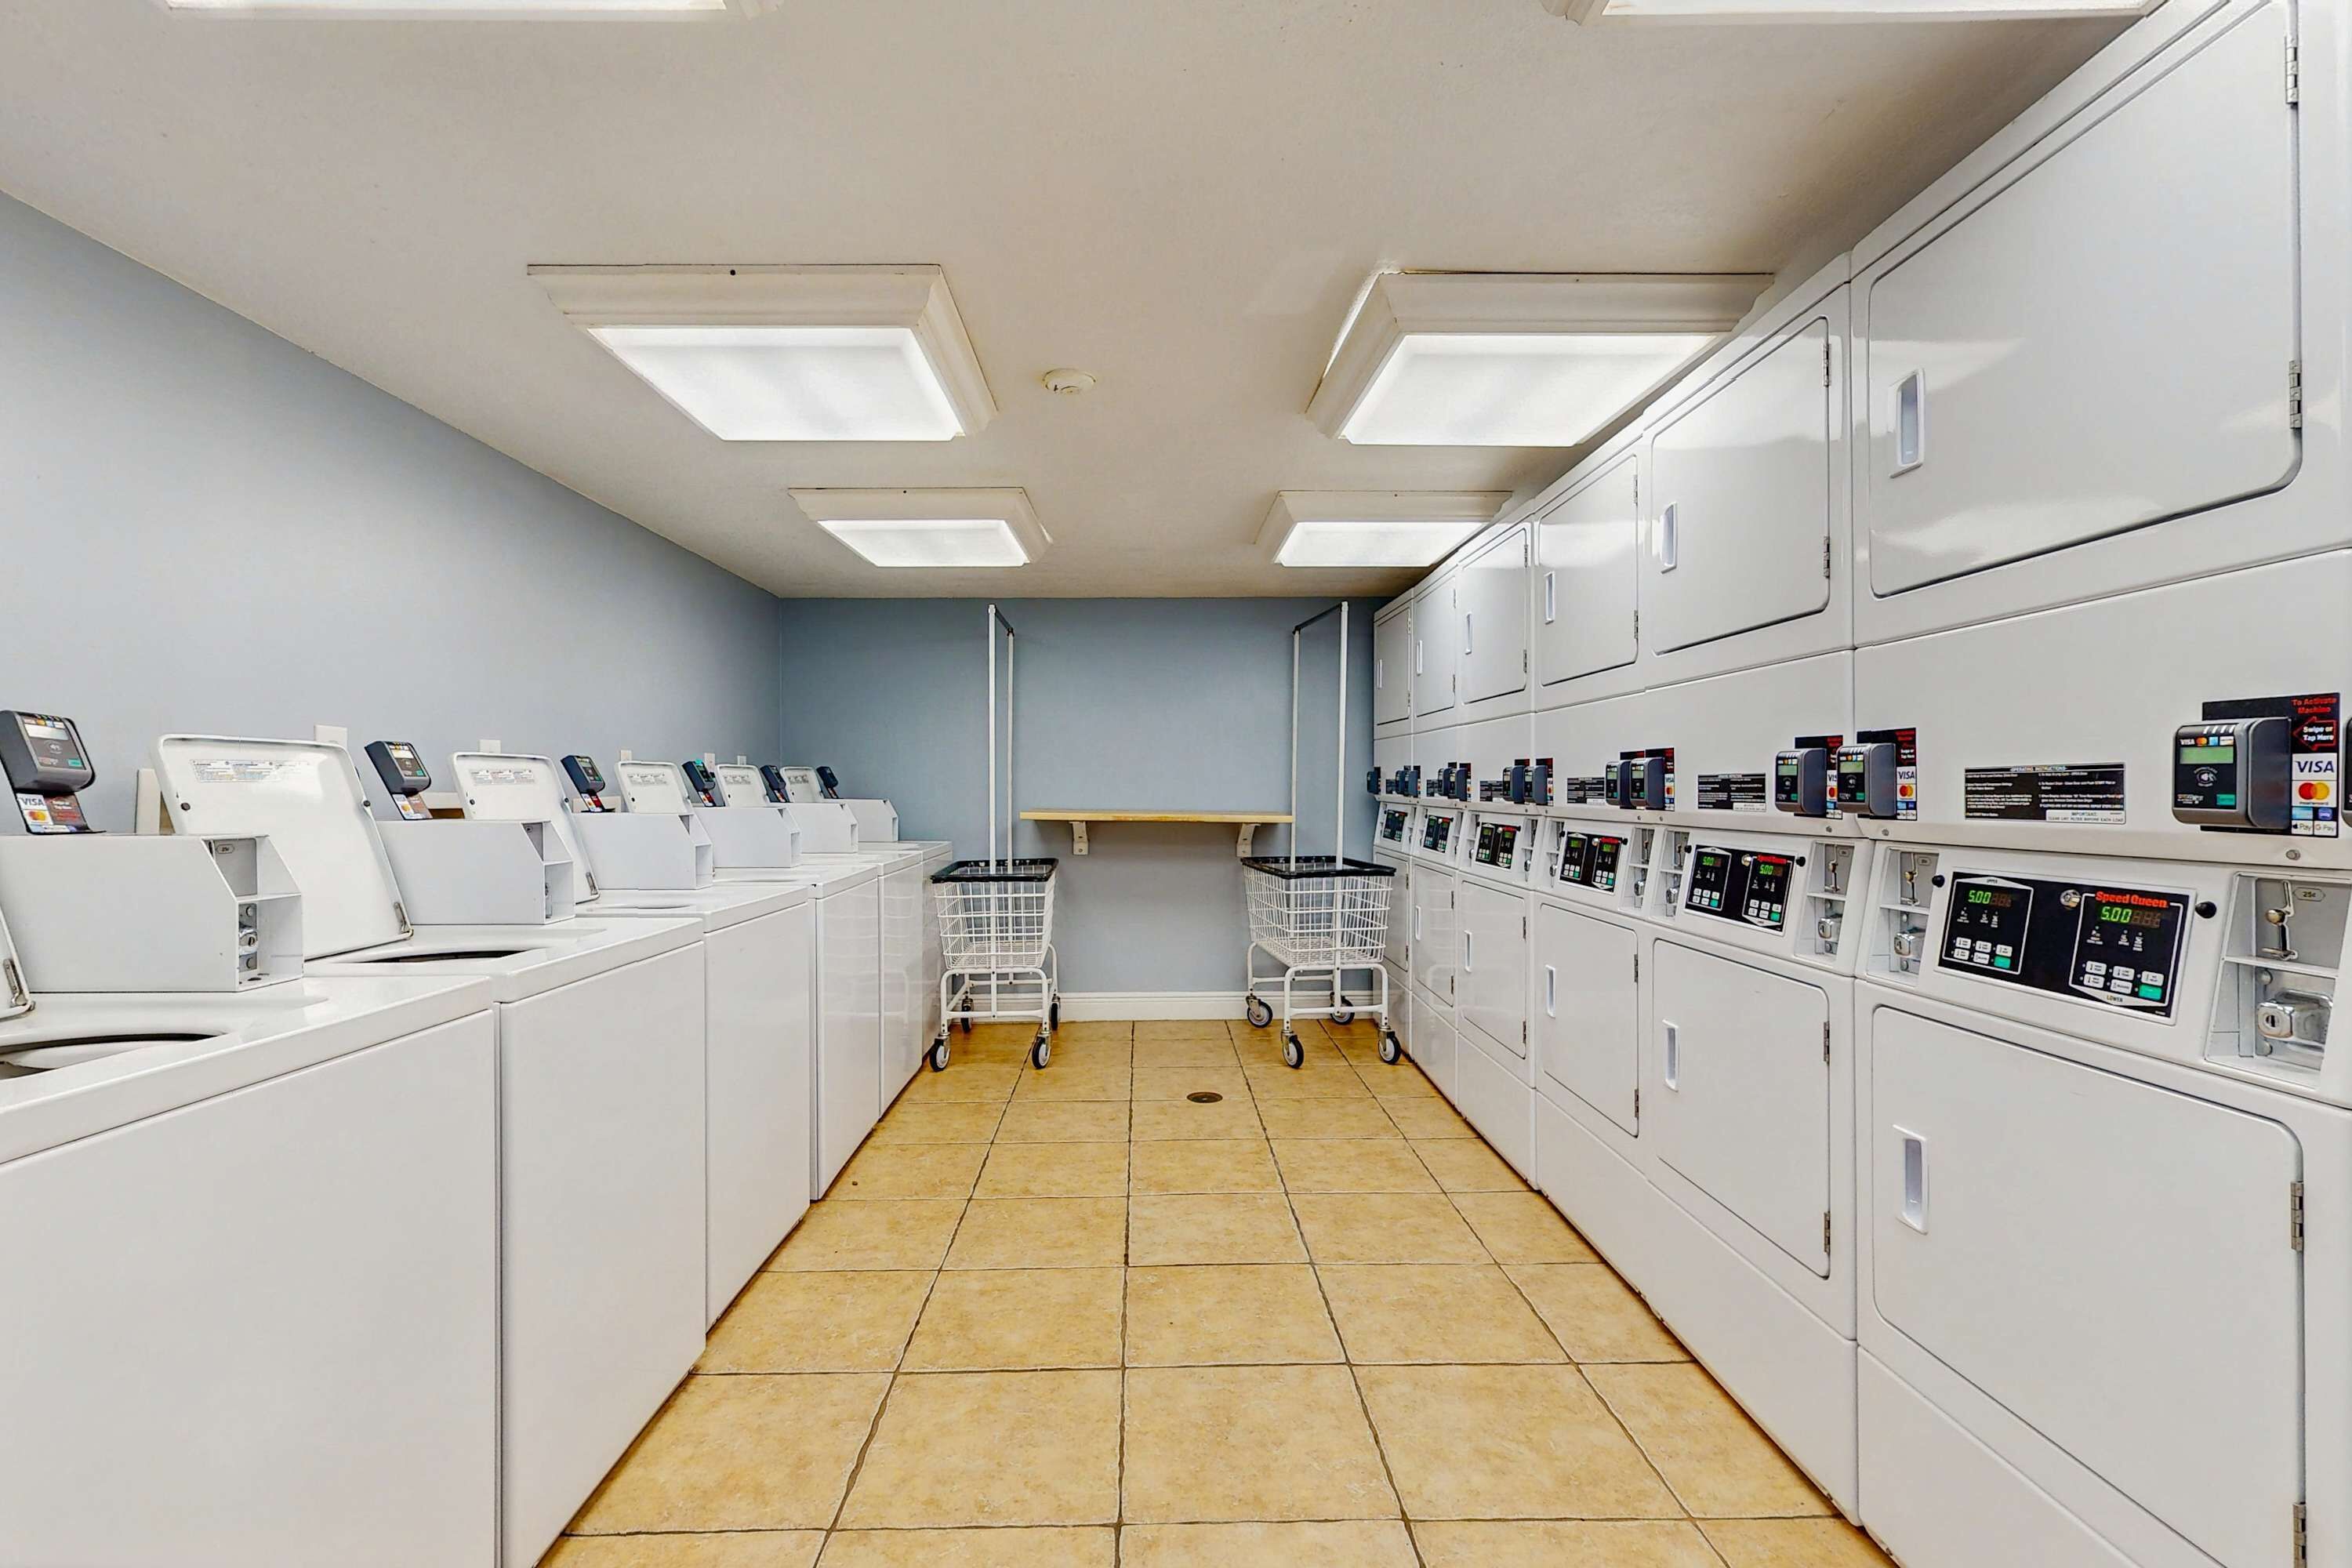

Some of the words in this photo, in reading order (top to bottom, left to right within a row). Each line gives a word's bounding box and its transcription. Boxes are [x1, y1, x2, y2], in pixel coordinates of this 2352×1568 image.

[2296, 760, 2335, 773] VISA
[1898, 771, 1915, 779] VISA
[20, 797, 45, 807] VISA
[2095, 891, 2130, 903] Speed
[2130, 894, 2169, 909] Queen
